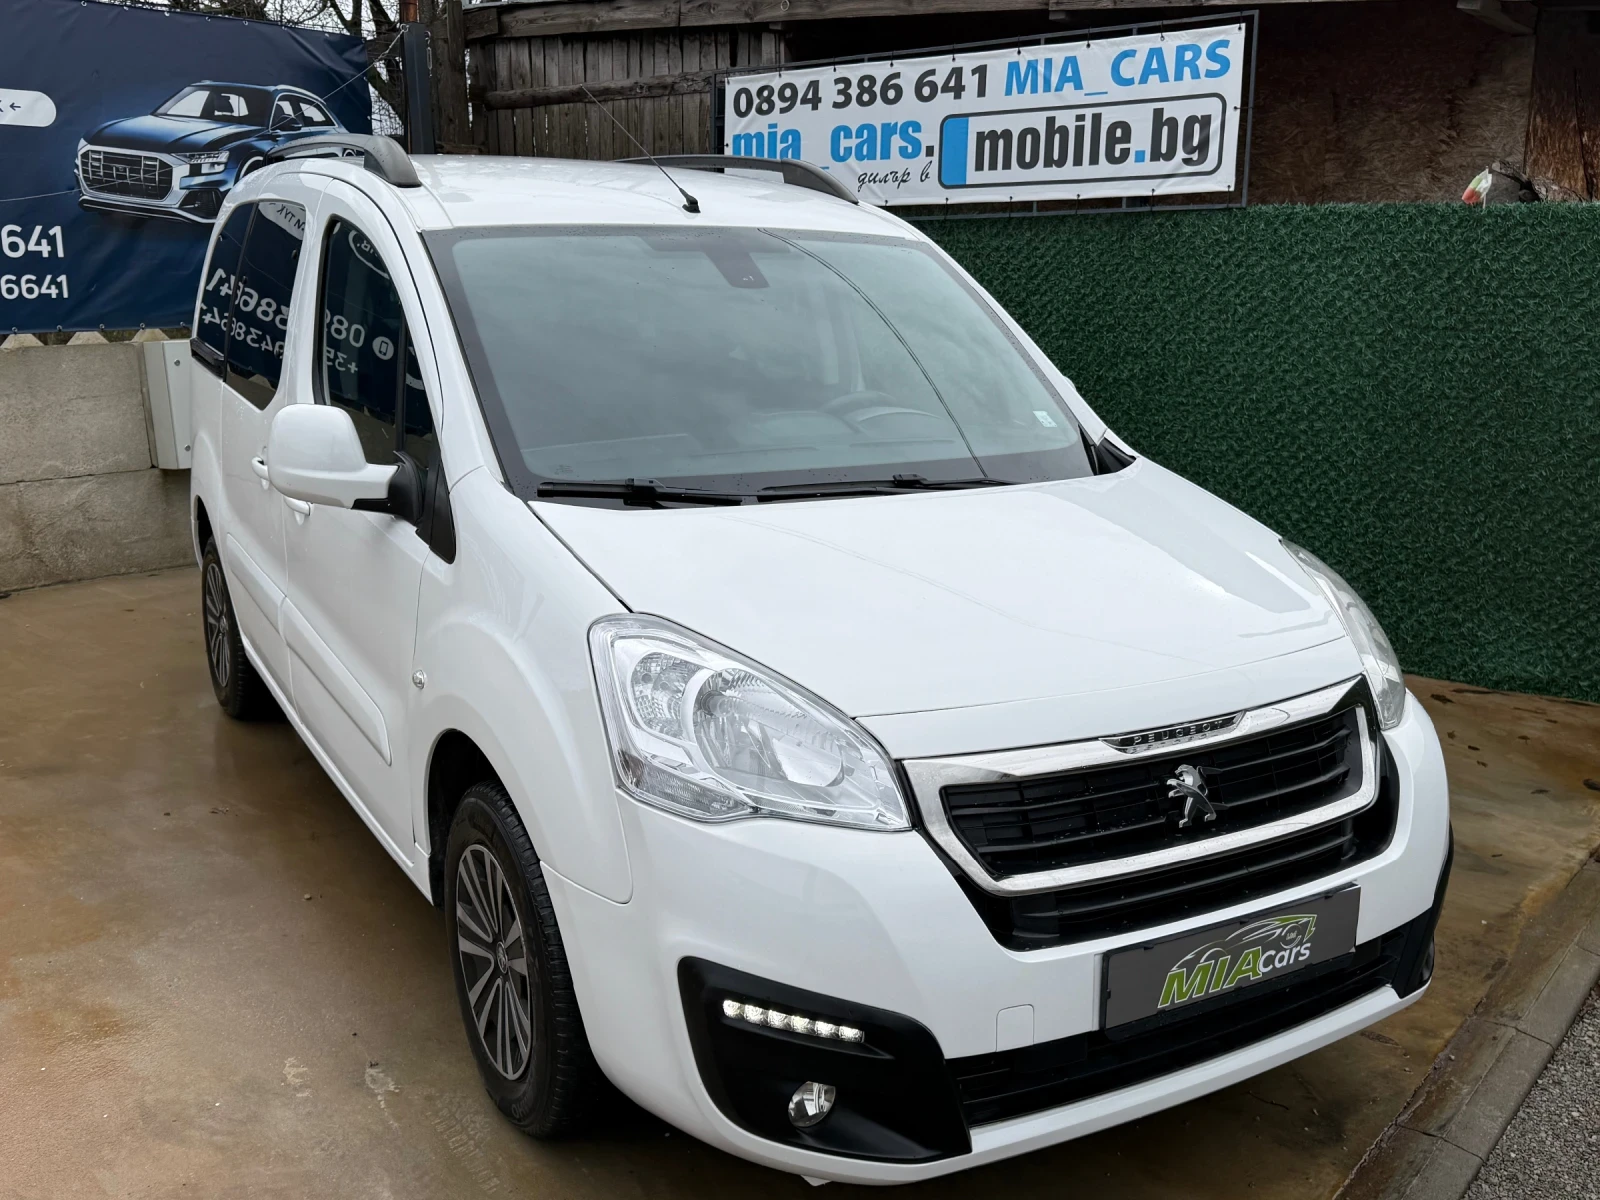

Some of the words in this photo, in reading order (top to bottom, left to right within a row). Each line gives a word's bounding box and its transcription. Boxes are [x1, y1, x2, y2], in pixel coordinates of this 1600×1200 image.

[733, 81, 822, 118] 0894
[831, 73, 902, 109] 386
[914, 64, 988, 102] 641
[1004, 39, 1232, 98] MIA_CARS
[974, 107, 1212, 172] mobile.bg
[1133, 720, 1223, 746] PEUGEOT
[1157, 946, 1262, 1009] MIA
